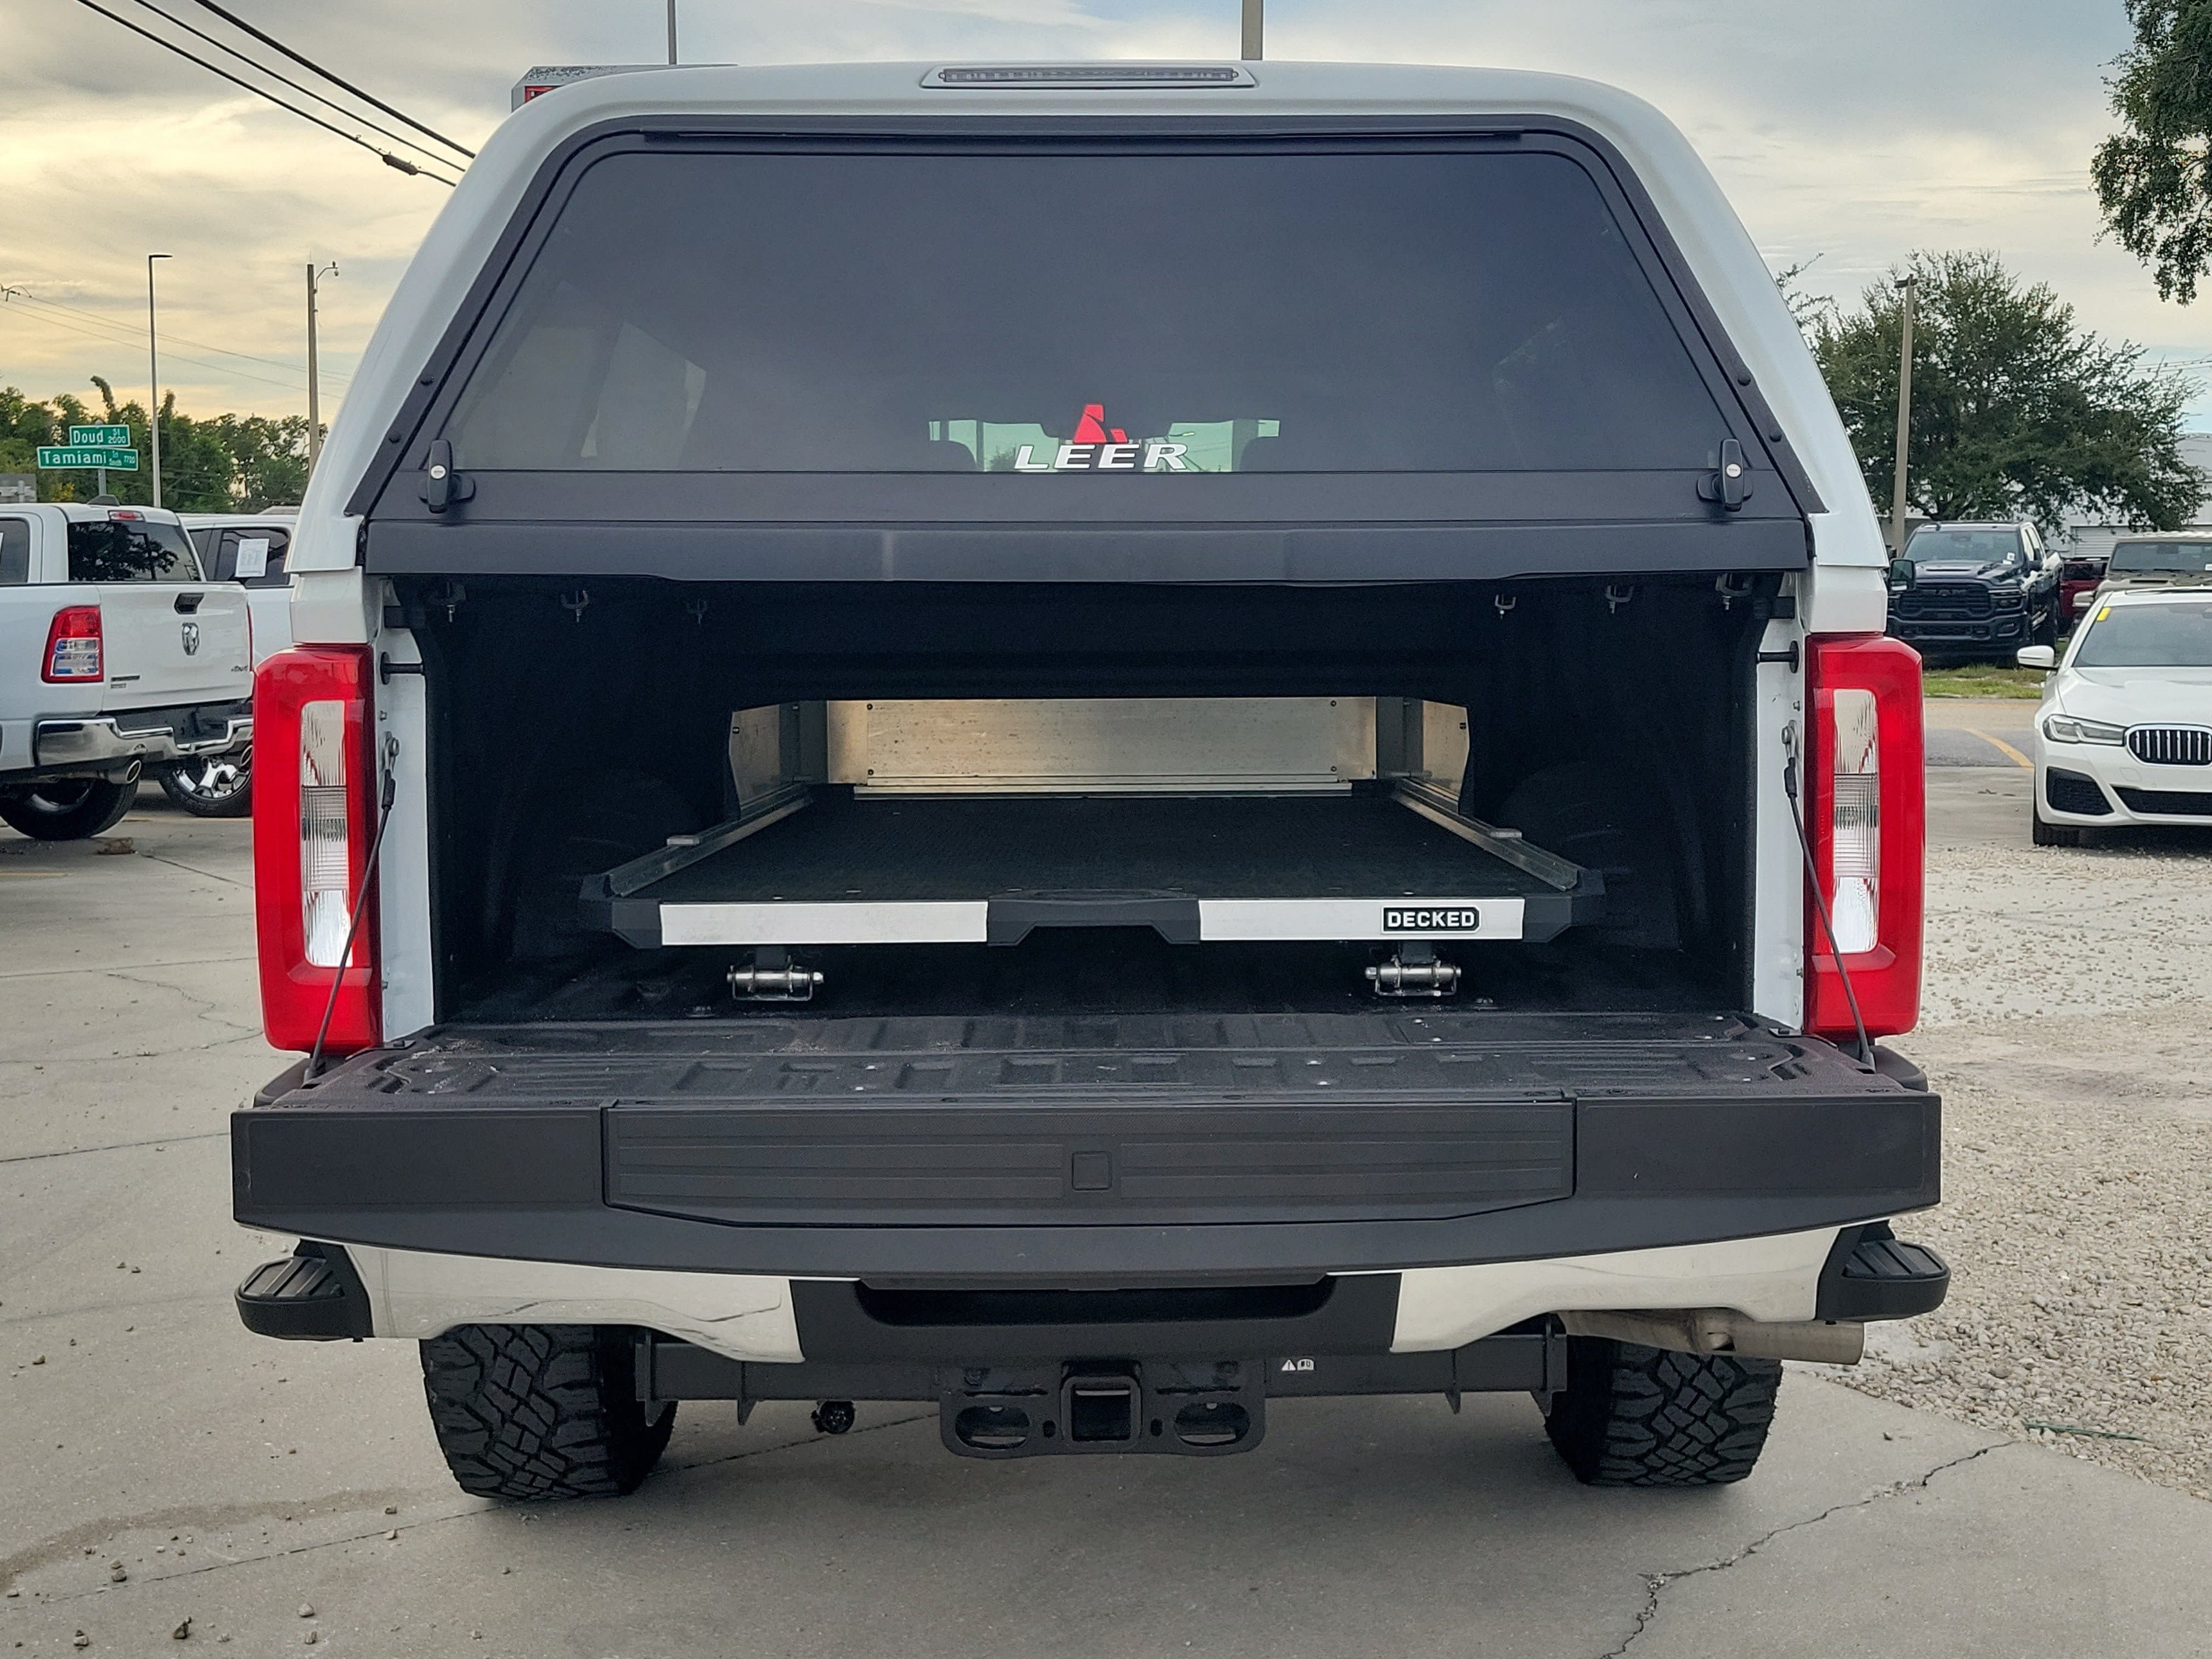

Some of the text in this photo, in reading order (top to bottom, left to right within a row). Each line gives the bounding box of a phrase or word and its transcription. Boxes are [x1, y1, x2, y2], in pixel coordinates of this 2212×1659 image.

[73, 430, 103, 443] Doud
[108, 435, 126, 444] 2000
[42, 450, 106, 464] Tamiami
[1014, 443, 1187, 470] LEER
[1387, 911, 1475, 928] DECKED
